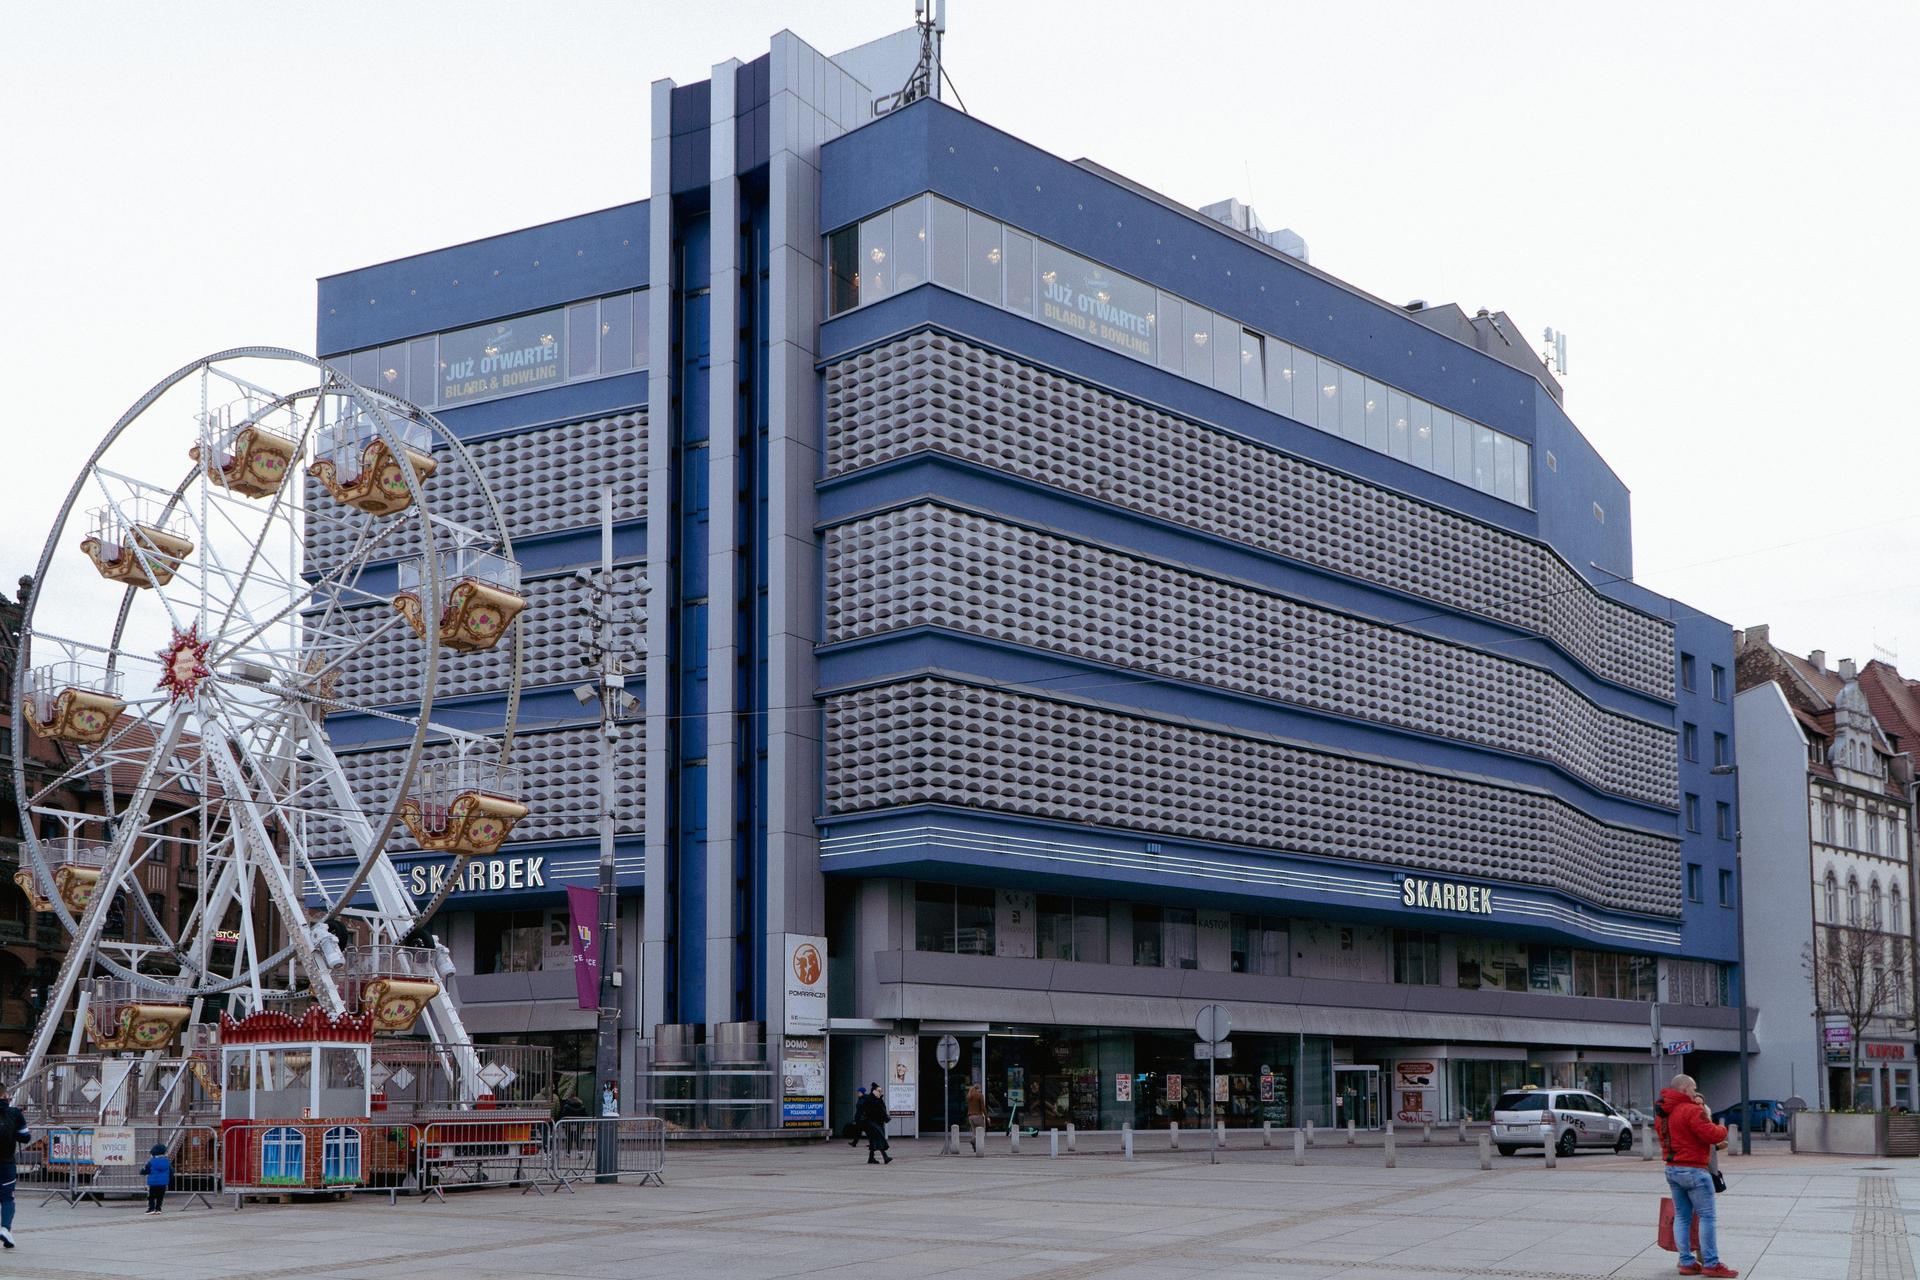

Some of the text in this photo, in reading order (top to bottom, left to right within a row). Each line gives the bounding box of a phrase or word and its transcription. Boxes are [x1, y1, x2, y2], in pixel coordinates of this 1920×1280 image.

[1044, 281, 1151, 338] JUŻ OTWARTE!
[1044, 302, 1151, 354] BILARD & BOWLING
[446, 341, 559, 381] JUŻ OTWARTE!
[445, 364, 557, 399] BILARD & BOWLING
[1404, 878, 1492, 914] SKARBEK
[788, 989, 826, 999] POMARANCZA
[1669, 1041, 1691, 1053] TAXI
[1867, 1043, 1904, 1058] KANTOR
[1561, 1113, 1586, 1131] LIDER
